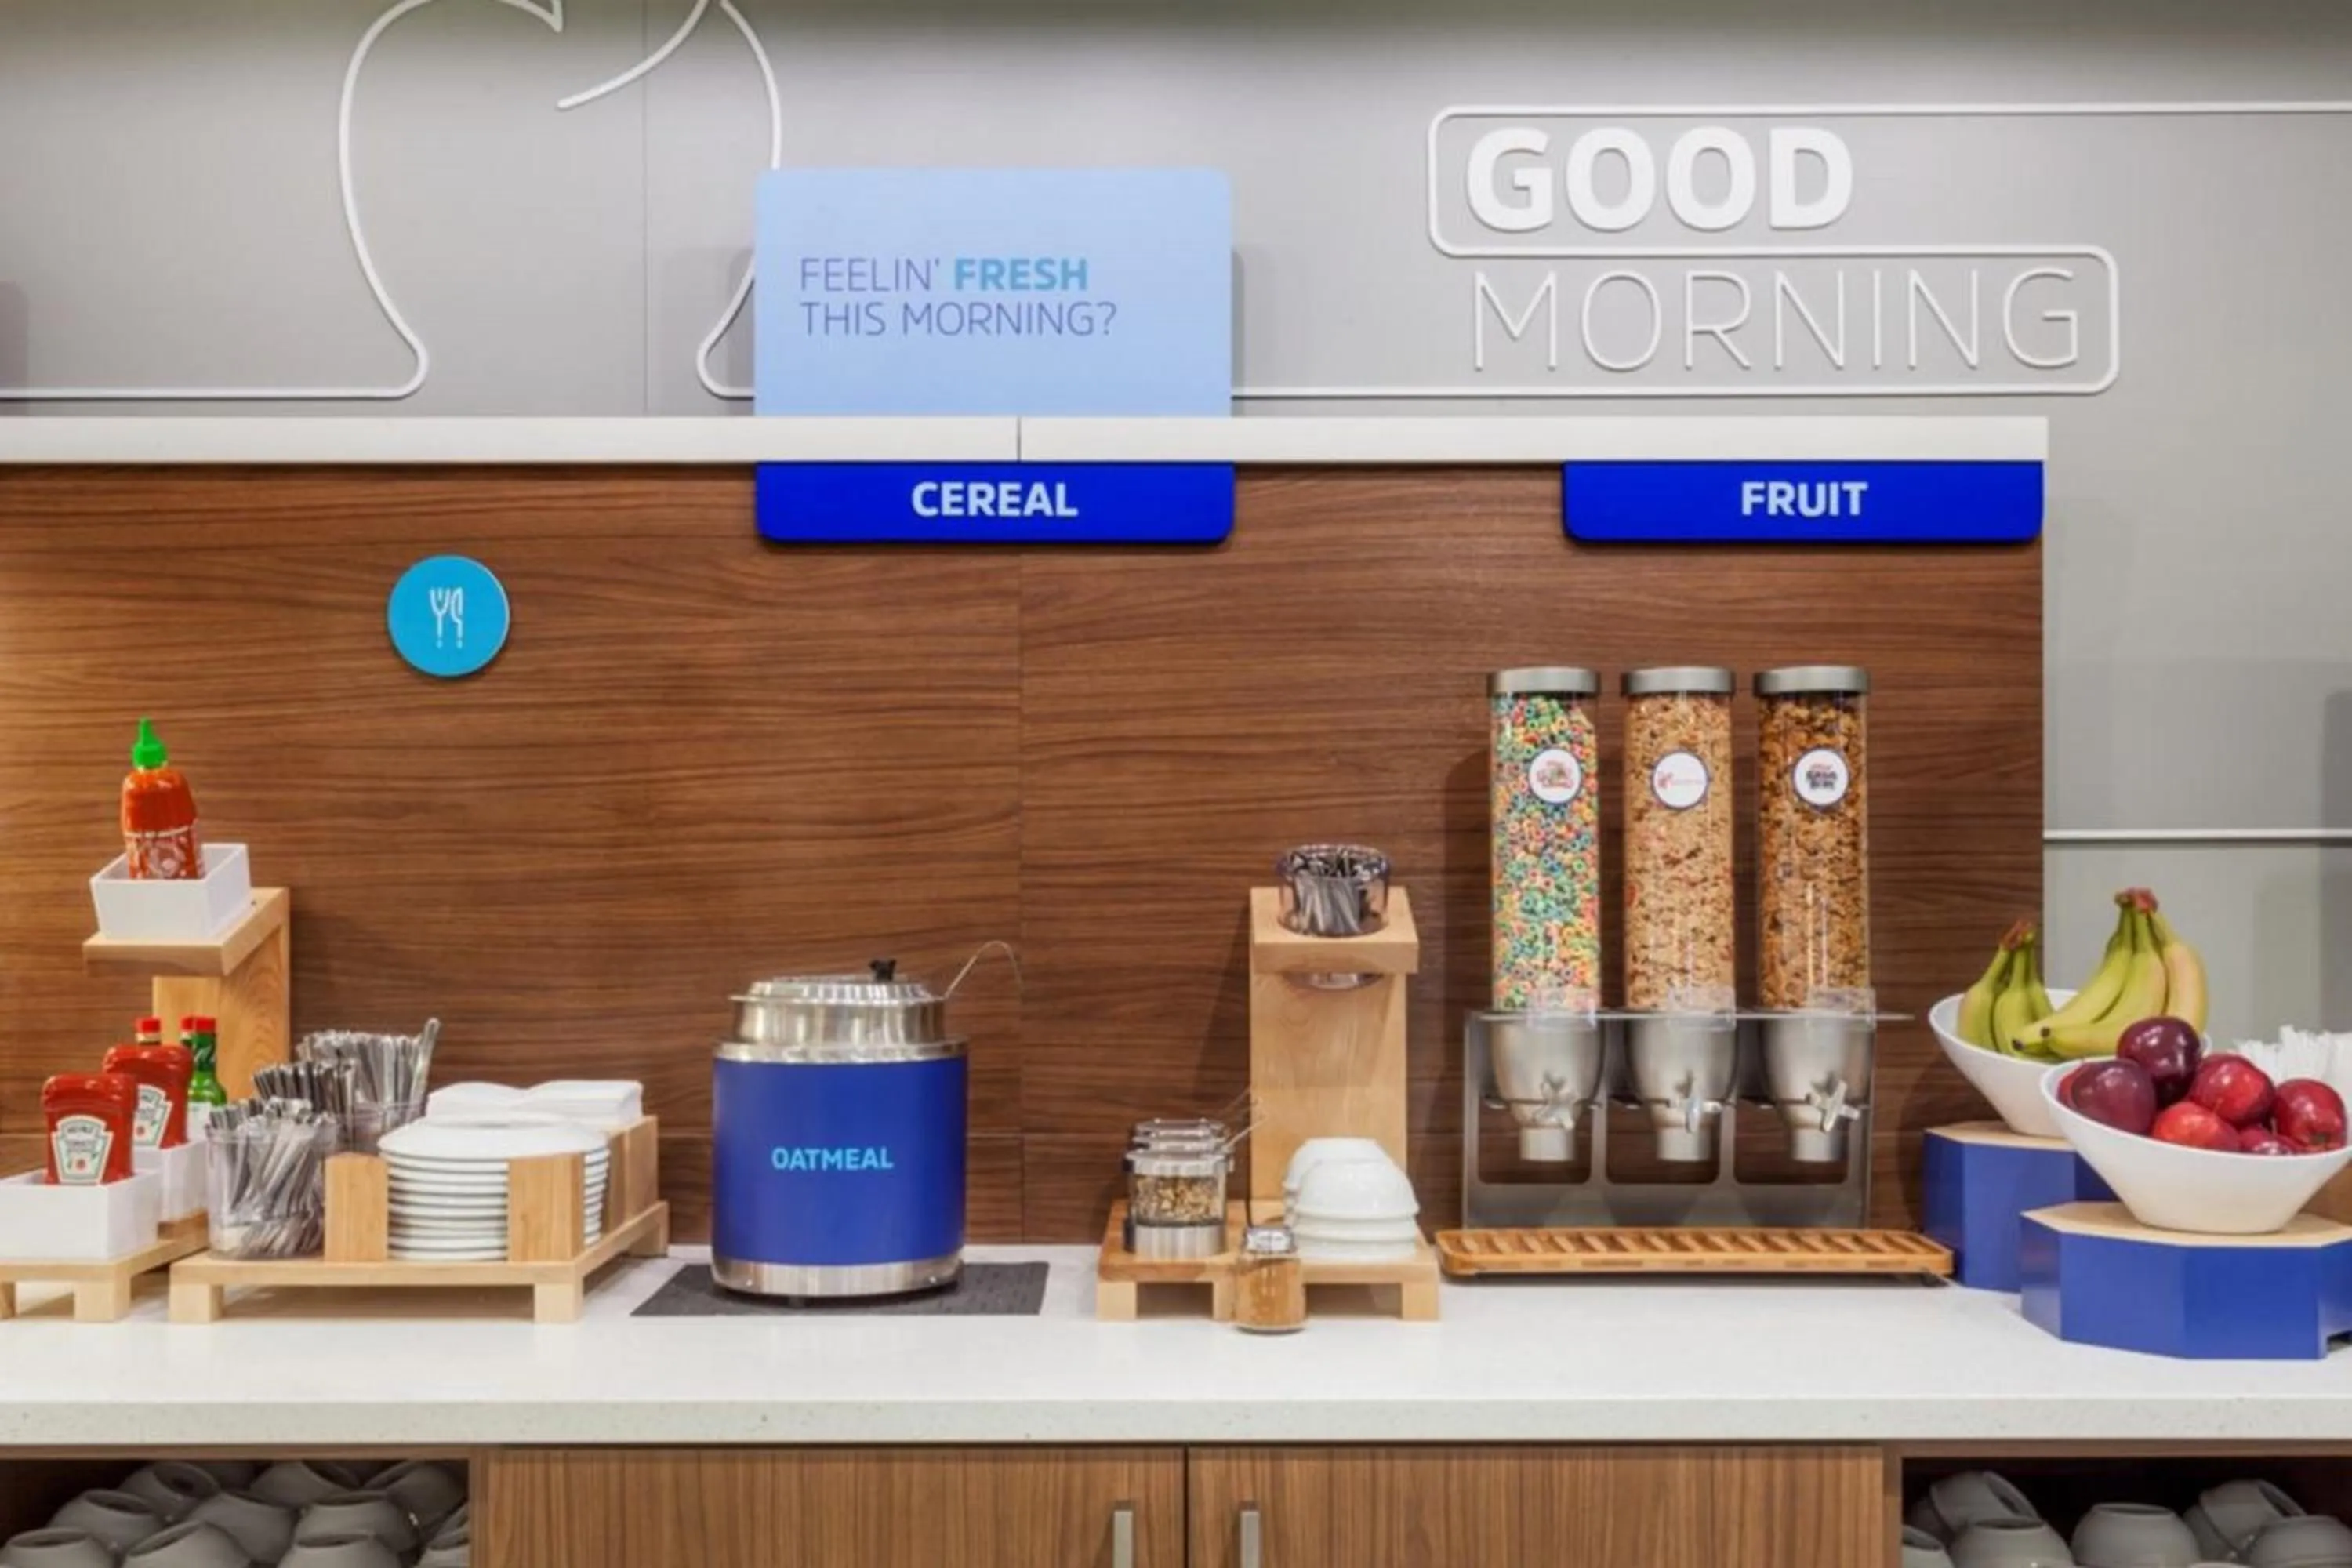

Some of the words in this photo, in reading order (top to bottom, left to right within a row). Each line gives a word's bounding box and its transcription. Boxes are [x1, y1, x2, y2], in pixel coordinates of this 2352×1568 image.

[1465, 125, 1854, 232] GOOD
[954, 258, 1088, 291] FRESH
[800, 300, 887, 336] THIS
[902, 300, 1118, 336] MORNING?
[1473, 267, 2081, 372] MORNING
[911, 481, 1078, 517] CEREAL
[1741, 481, 1868, 517] FRUIT
[771, 1146, 895, 1171] OATMEAL
